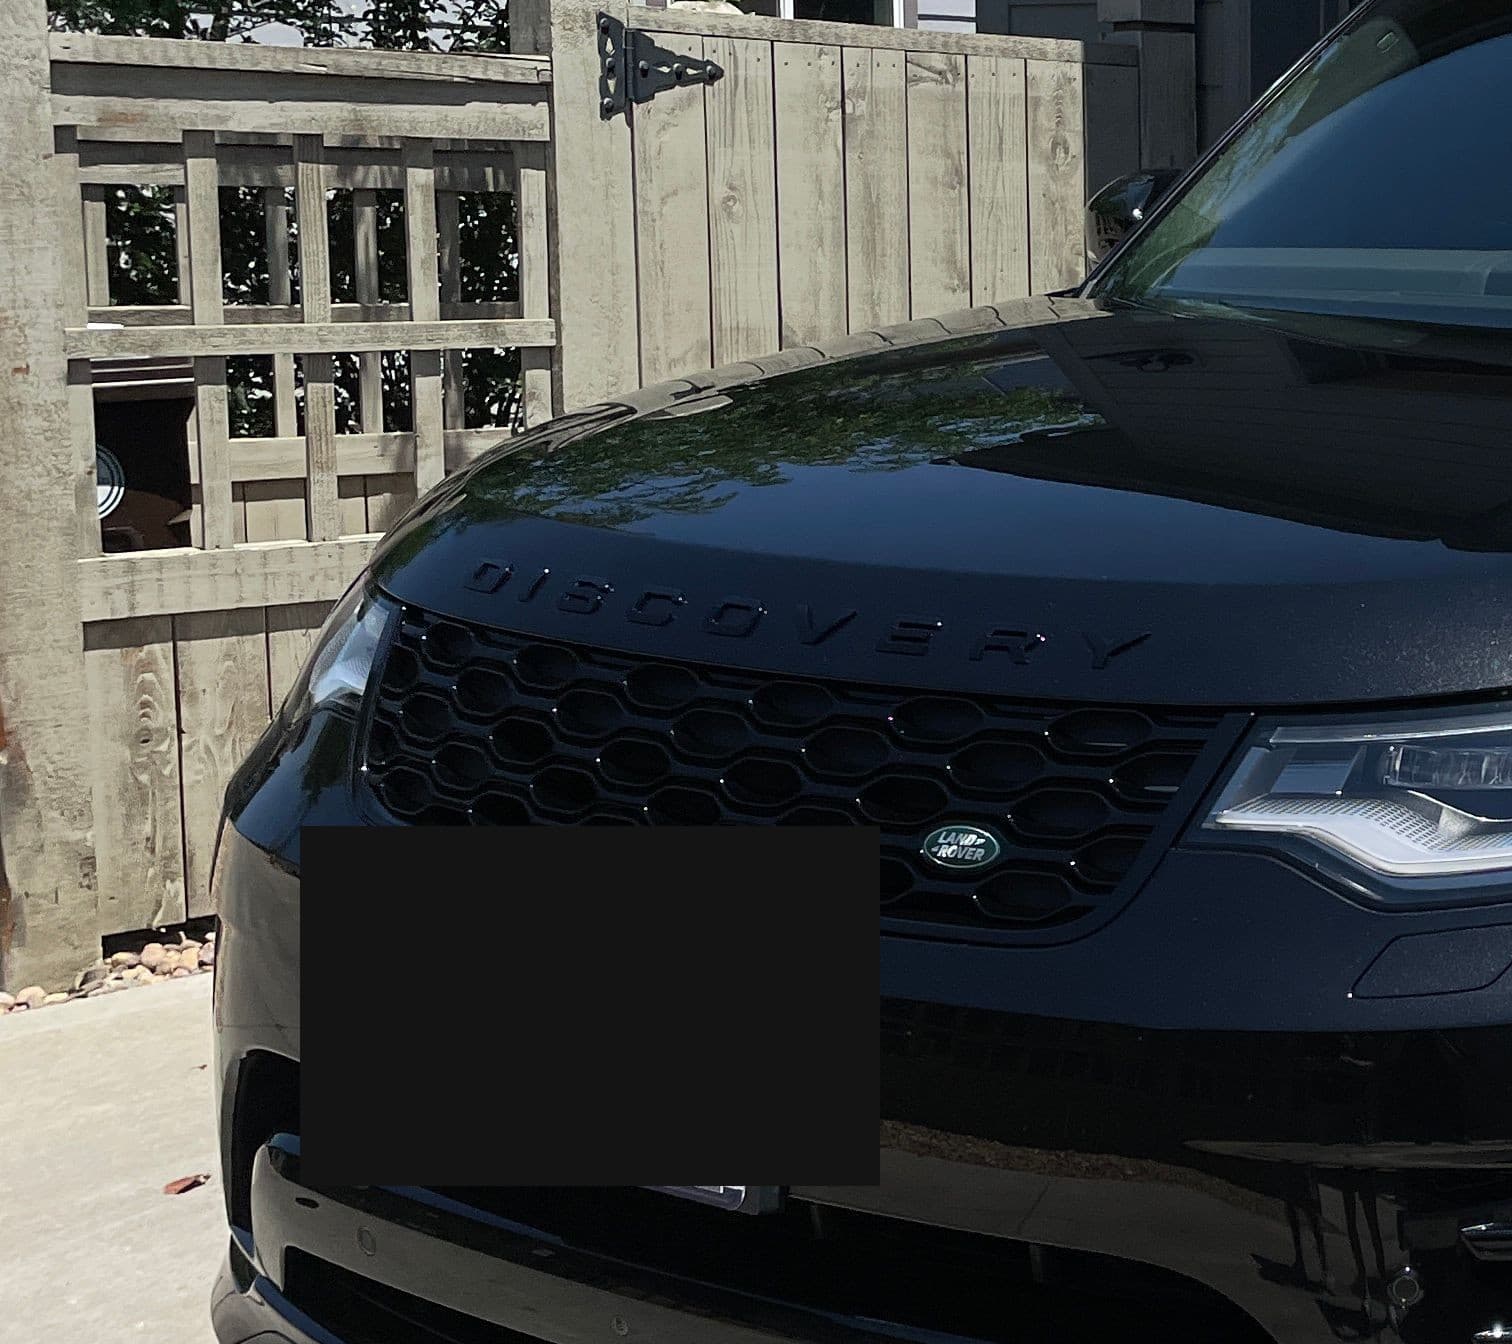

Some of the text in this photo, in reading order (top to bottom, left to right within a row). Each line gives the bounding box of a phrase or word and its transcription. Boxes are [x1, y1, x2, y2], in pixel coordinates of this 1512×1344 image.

[463, 558, 1153, 671] DISCOVERY
[937, 831, 978, 846] LAND
[936, 844, 985, 860] ROVER
